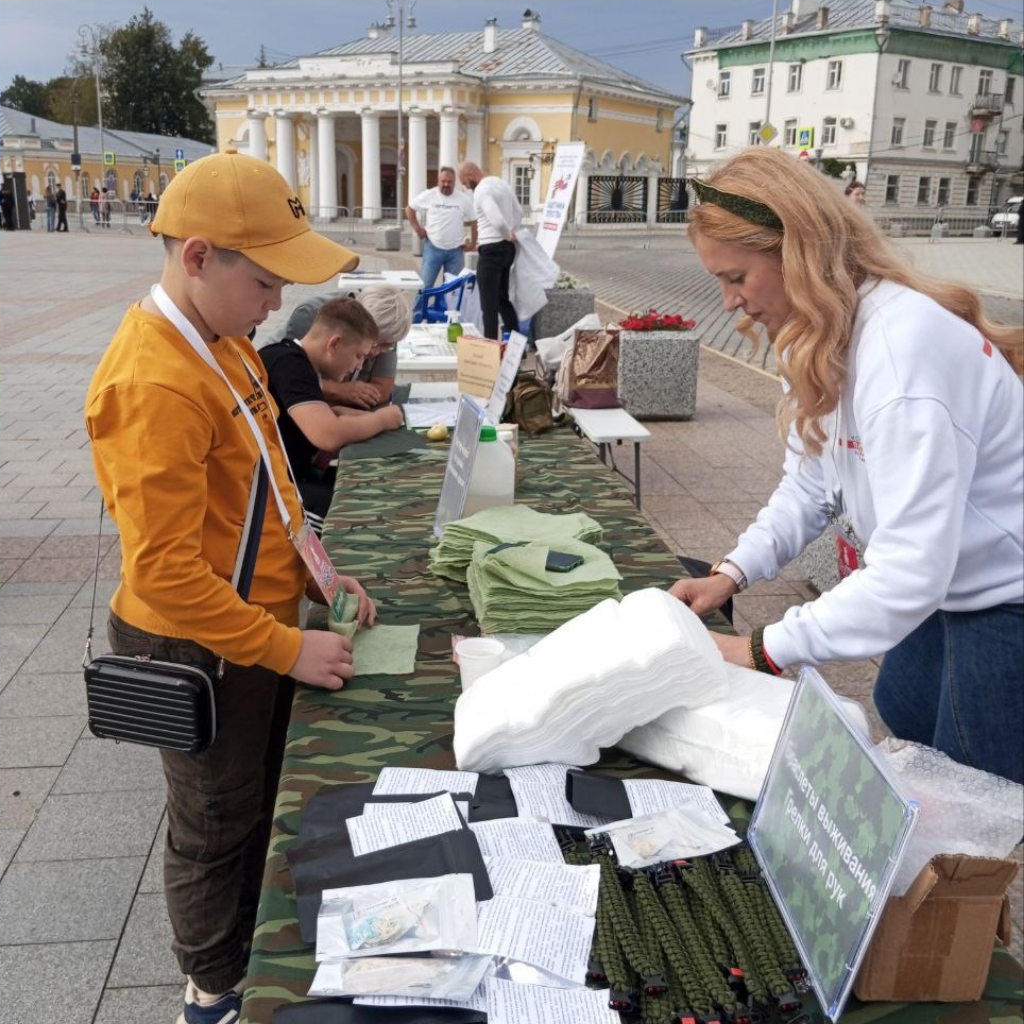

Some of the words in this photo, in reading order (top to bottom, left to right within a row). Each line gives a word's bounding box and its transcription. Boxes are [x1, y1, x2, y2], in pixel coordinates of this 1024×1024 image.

[784, 787, 812, 847] Грелки
[808, 842, 829, 876] для
[825, 871, 848, 910] рук
[817, 802, 878, 904] выживания
